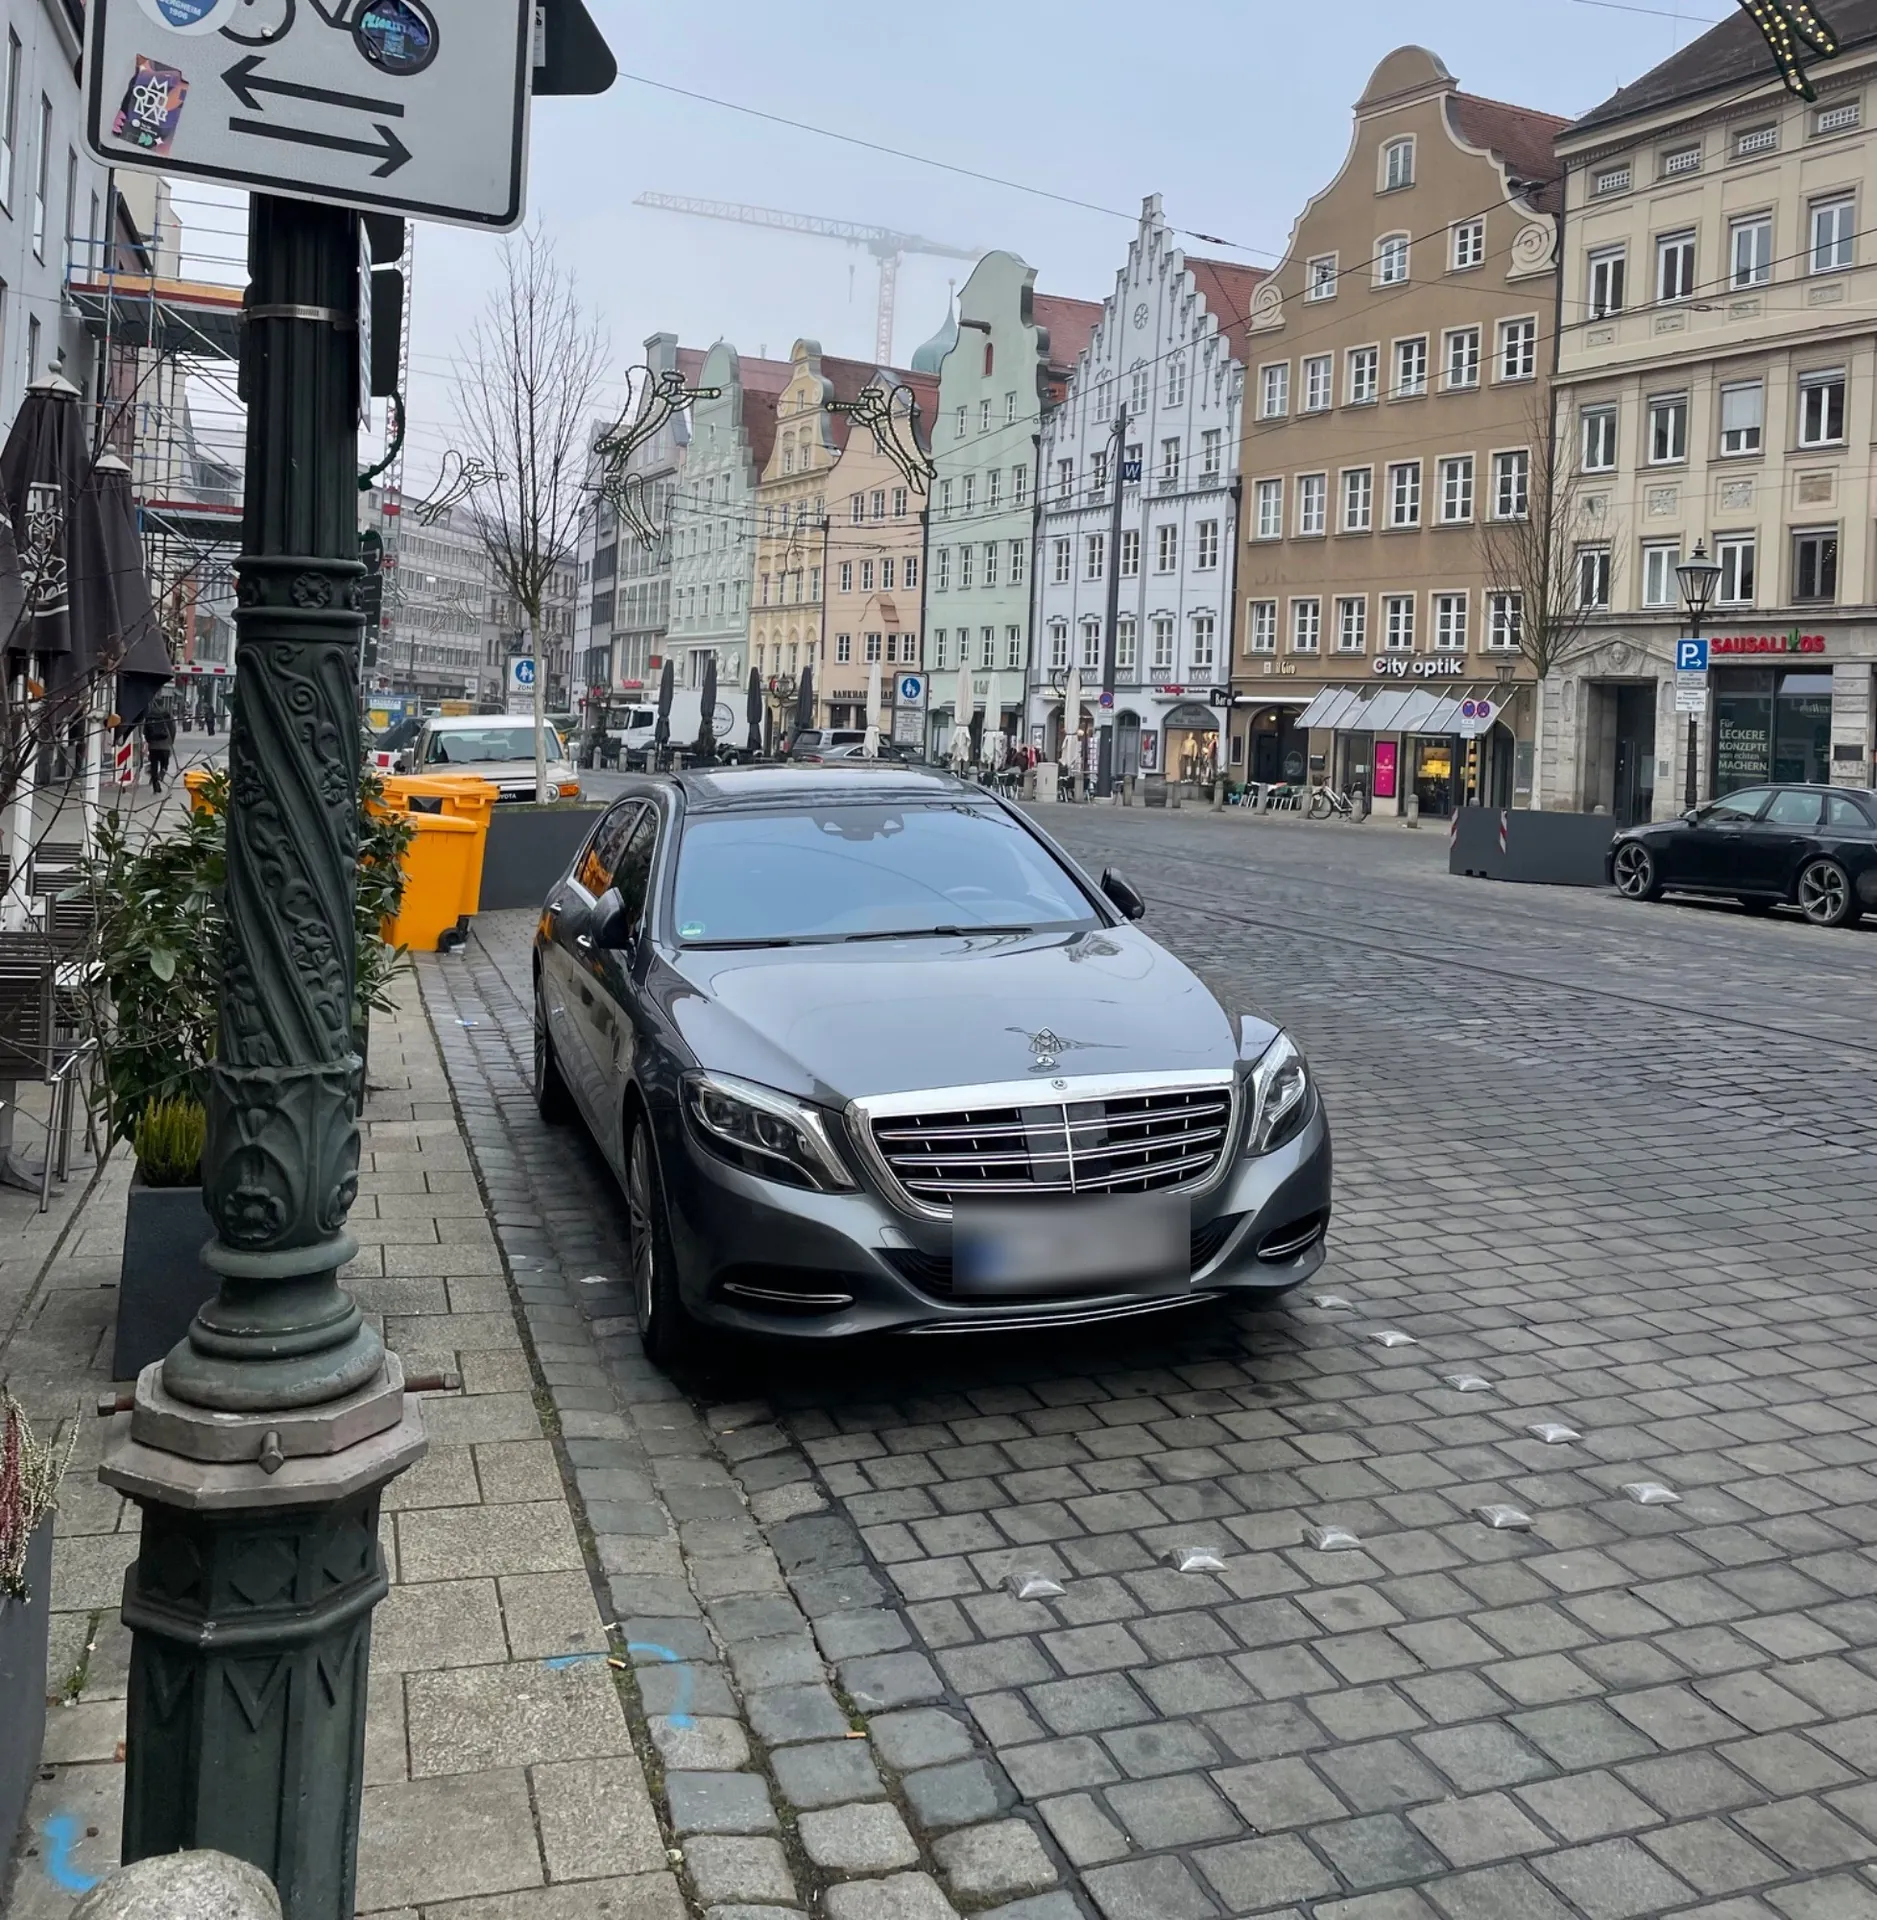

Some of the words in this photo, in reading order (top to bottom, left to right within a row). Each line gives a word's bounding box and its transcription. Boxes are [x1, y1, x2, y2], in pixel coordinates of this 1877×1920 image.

[158, 0, 202, 17] ERGHEIM
[1126, 464, 1140, 477] W
[1681, 643, 1699, 667] P
[1373, 657, 1408, 677] City
[1412, 657, 1463, 677] optik
[833, 690, 868, 699] BANKHAU
[1719, 718, 1735, 728] Für
[1719, 729, 1766, 741] LECKERE
[1718, 742, 1768, 752] KONZEPTE
[500, 792, 517, 800] YOTA
